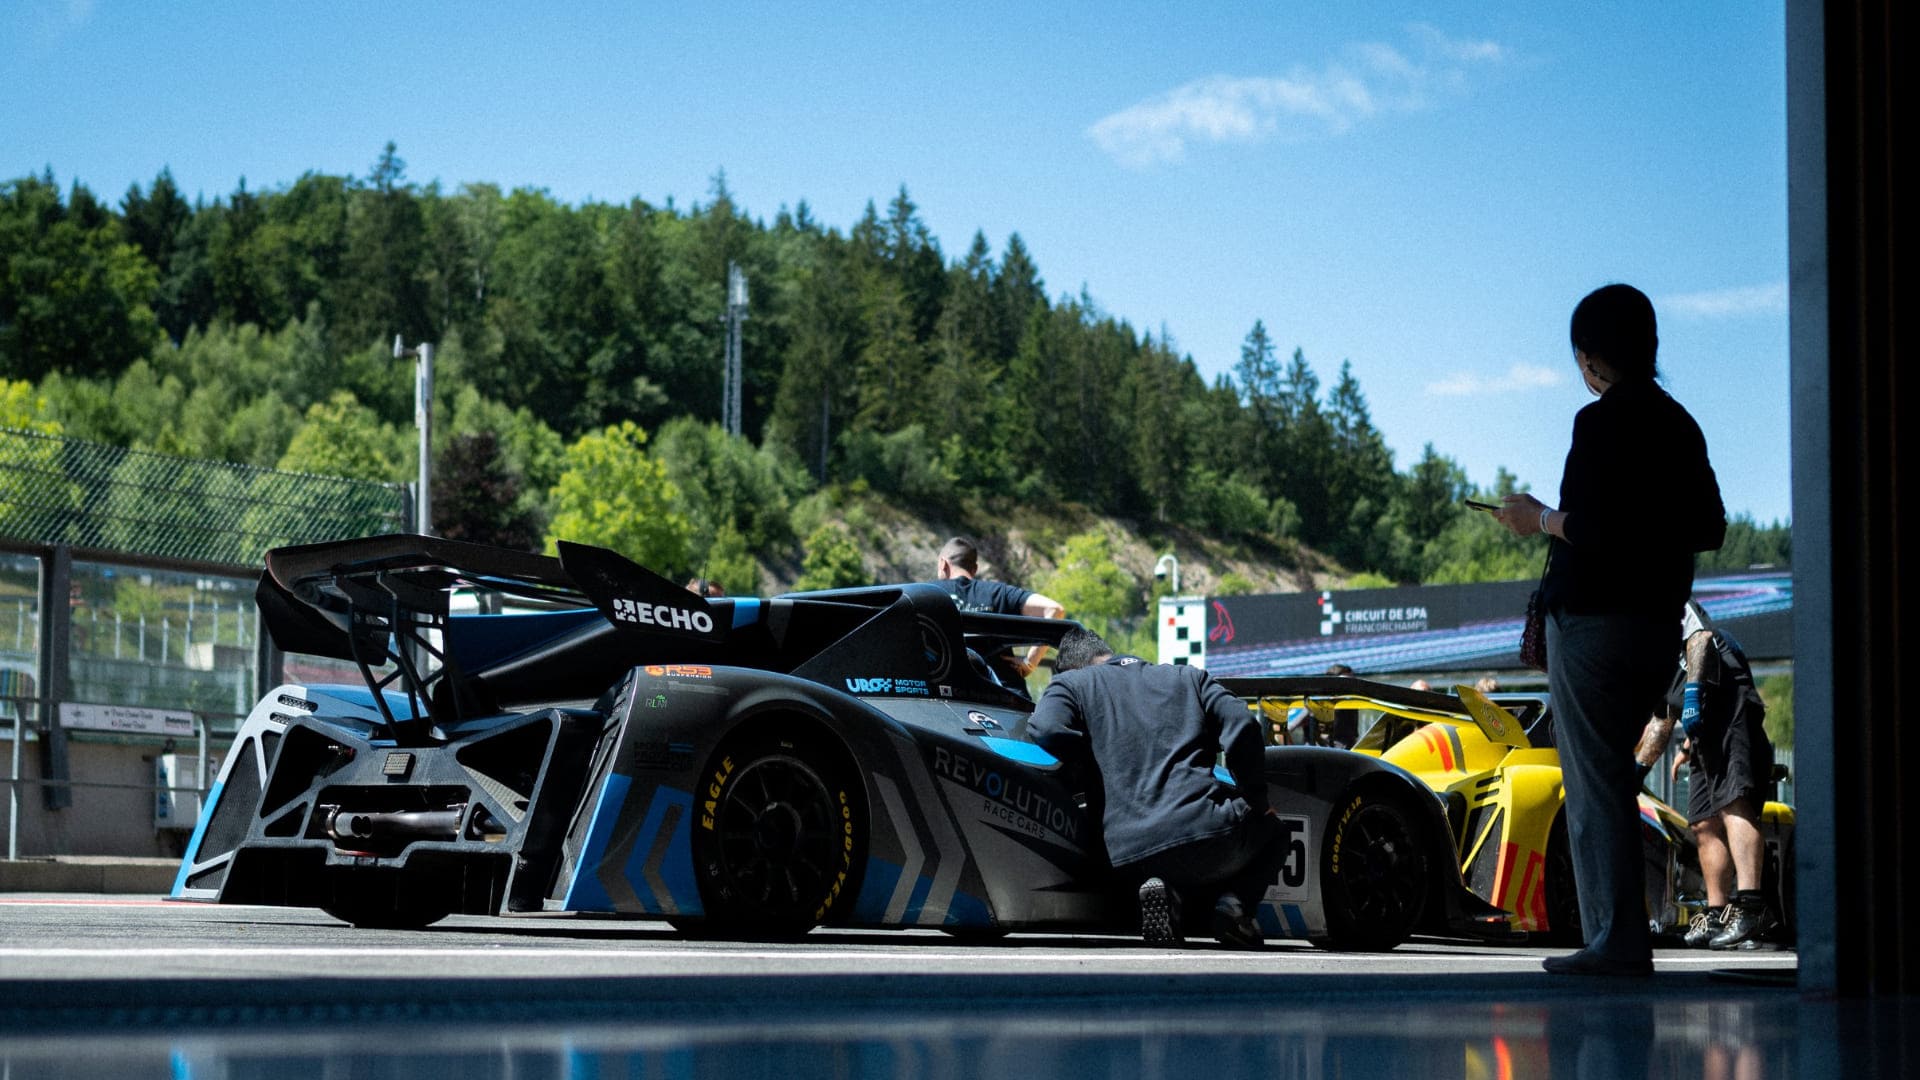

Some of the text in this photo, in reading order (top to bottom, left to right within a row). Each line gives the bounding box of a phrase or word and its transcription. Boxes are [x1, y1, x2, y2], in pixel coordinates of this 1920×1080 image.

[636, 602, 713, 633] ECHO
[1345, 607, 1428, 622] CIRCUIT DE SPA
[1345, 620, 1428, 633] FRANCORCHAMPS
[895, 679, 926, 687] MOTOR
[895, 686, 929, 695] SPORTS
[702, 755, 735, 831] EAGLE
[934, 746, 1078, 839] REVOLUTION
[983, 800, 1046, 839] RACE CARS
[1331, 796, 1362, 874] GOODYEAR
[815, 790, 852, 921] GOODYEAR
